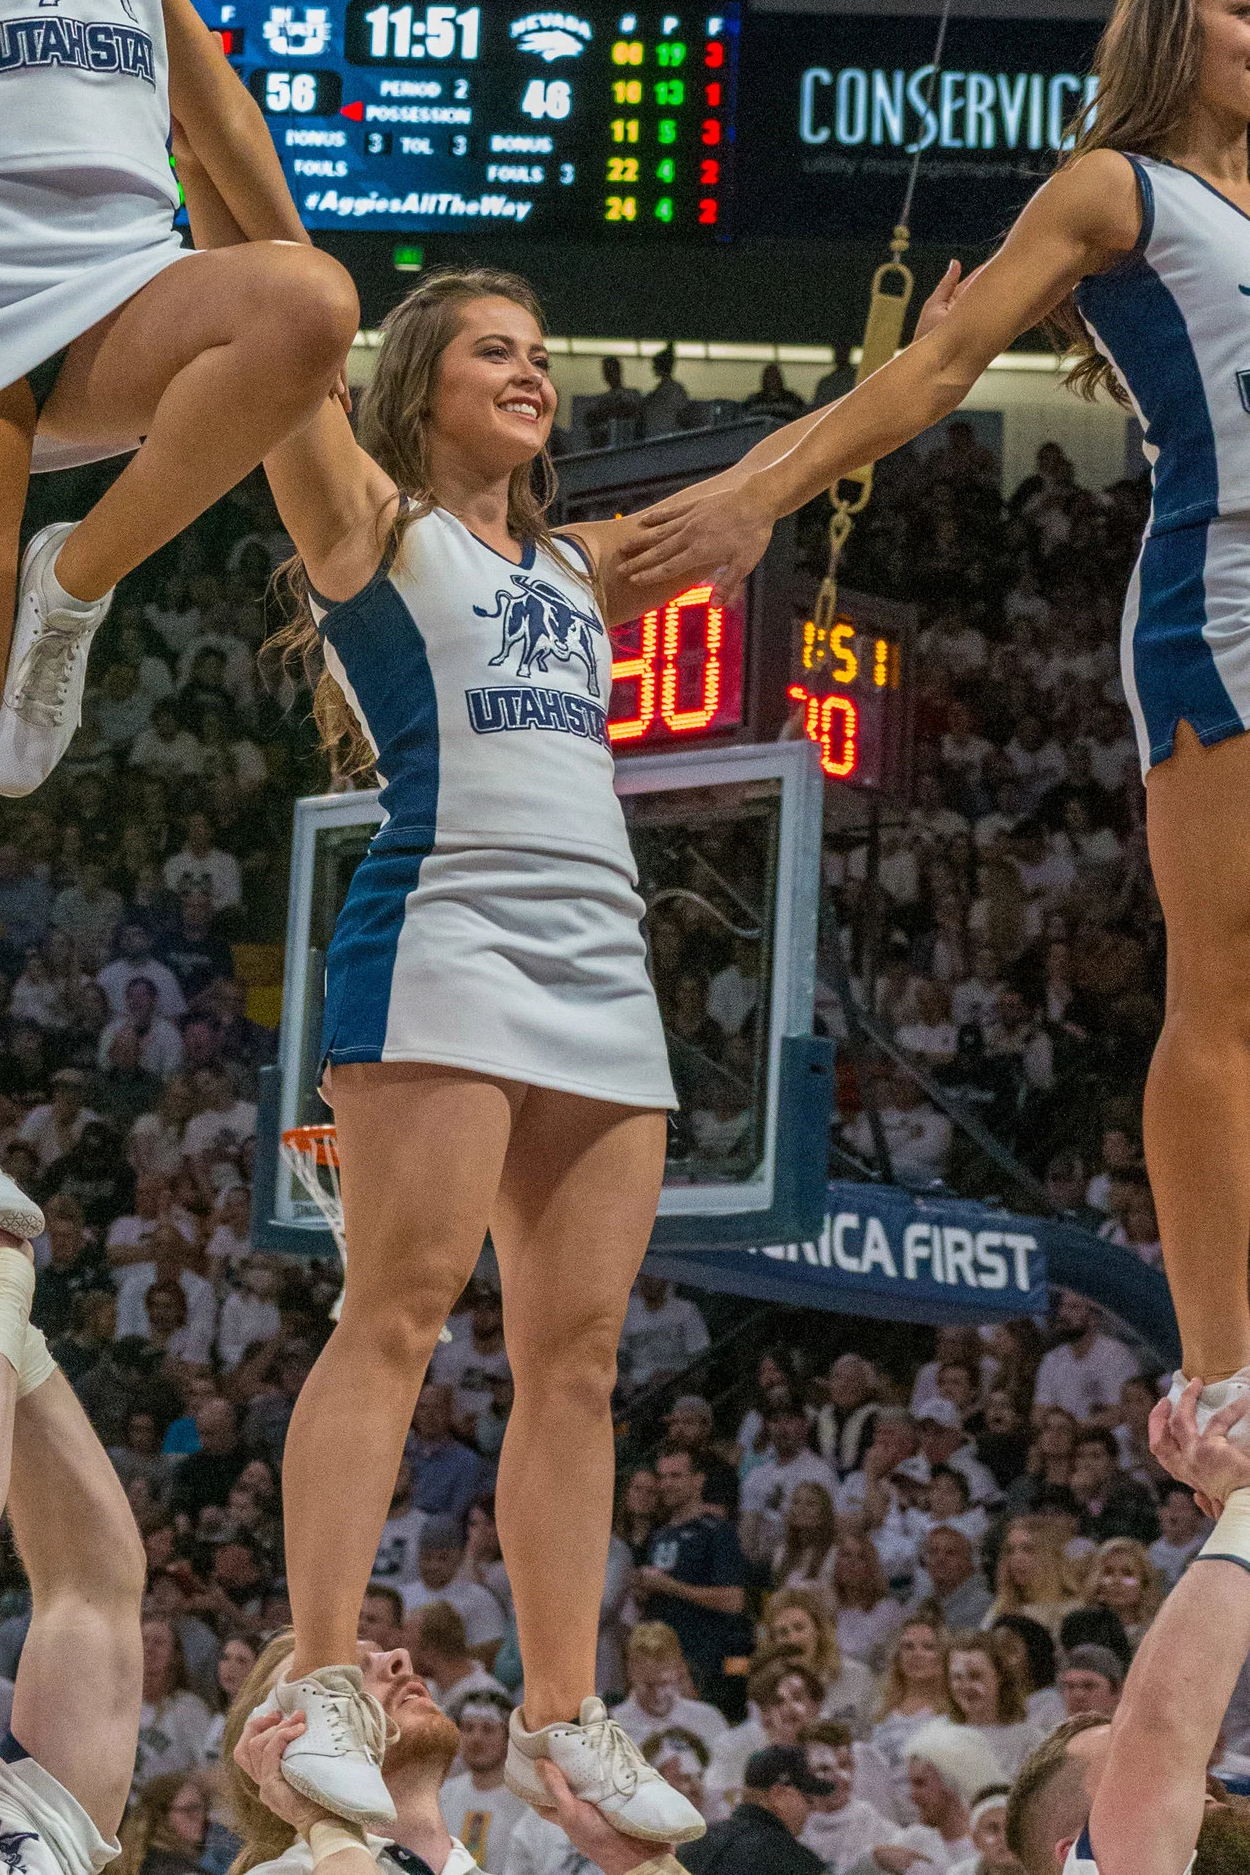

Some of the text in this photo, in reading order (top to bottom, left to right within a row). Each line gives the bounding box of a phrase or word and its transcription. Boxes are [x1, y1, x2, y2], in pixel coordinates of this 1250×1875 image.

[365, 5, 480, 59] 11:51
[510, 12, 592, 39] NEVADA
[656, 42, 686, 67] 19
[705, 42, 724, 68] 3
[266, 72, 316, 112] 56
[380, 79, 469, 100] PERIOD 2
[523, 80, 571, 119] 46
[655, 80, 684, 105] 13
[705, 82, 721, 107] 1
[365, 105, 473, 125] POSSESSION
[367, 133, 468, 156] 3 TOL 3
[489, 134, 553, 154] BONUS
[610, 119, 639, 143] 11
[702, 119, 721, 145] 3
[294, 159, 349, 177] FOULS
[486, 163, 575, 185] FOULS 3
[606, 158, 719, 185] 22 4 2
[304, 190, 534, 223] #AggiesAllTheWay
[604, 197, 718, 224] 24 4 2
[465, 686, 570, 734] UTAH
[904, 1224, 1038, 1292] FIRST
